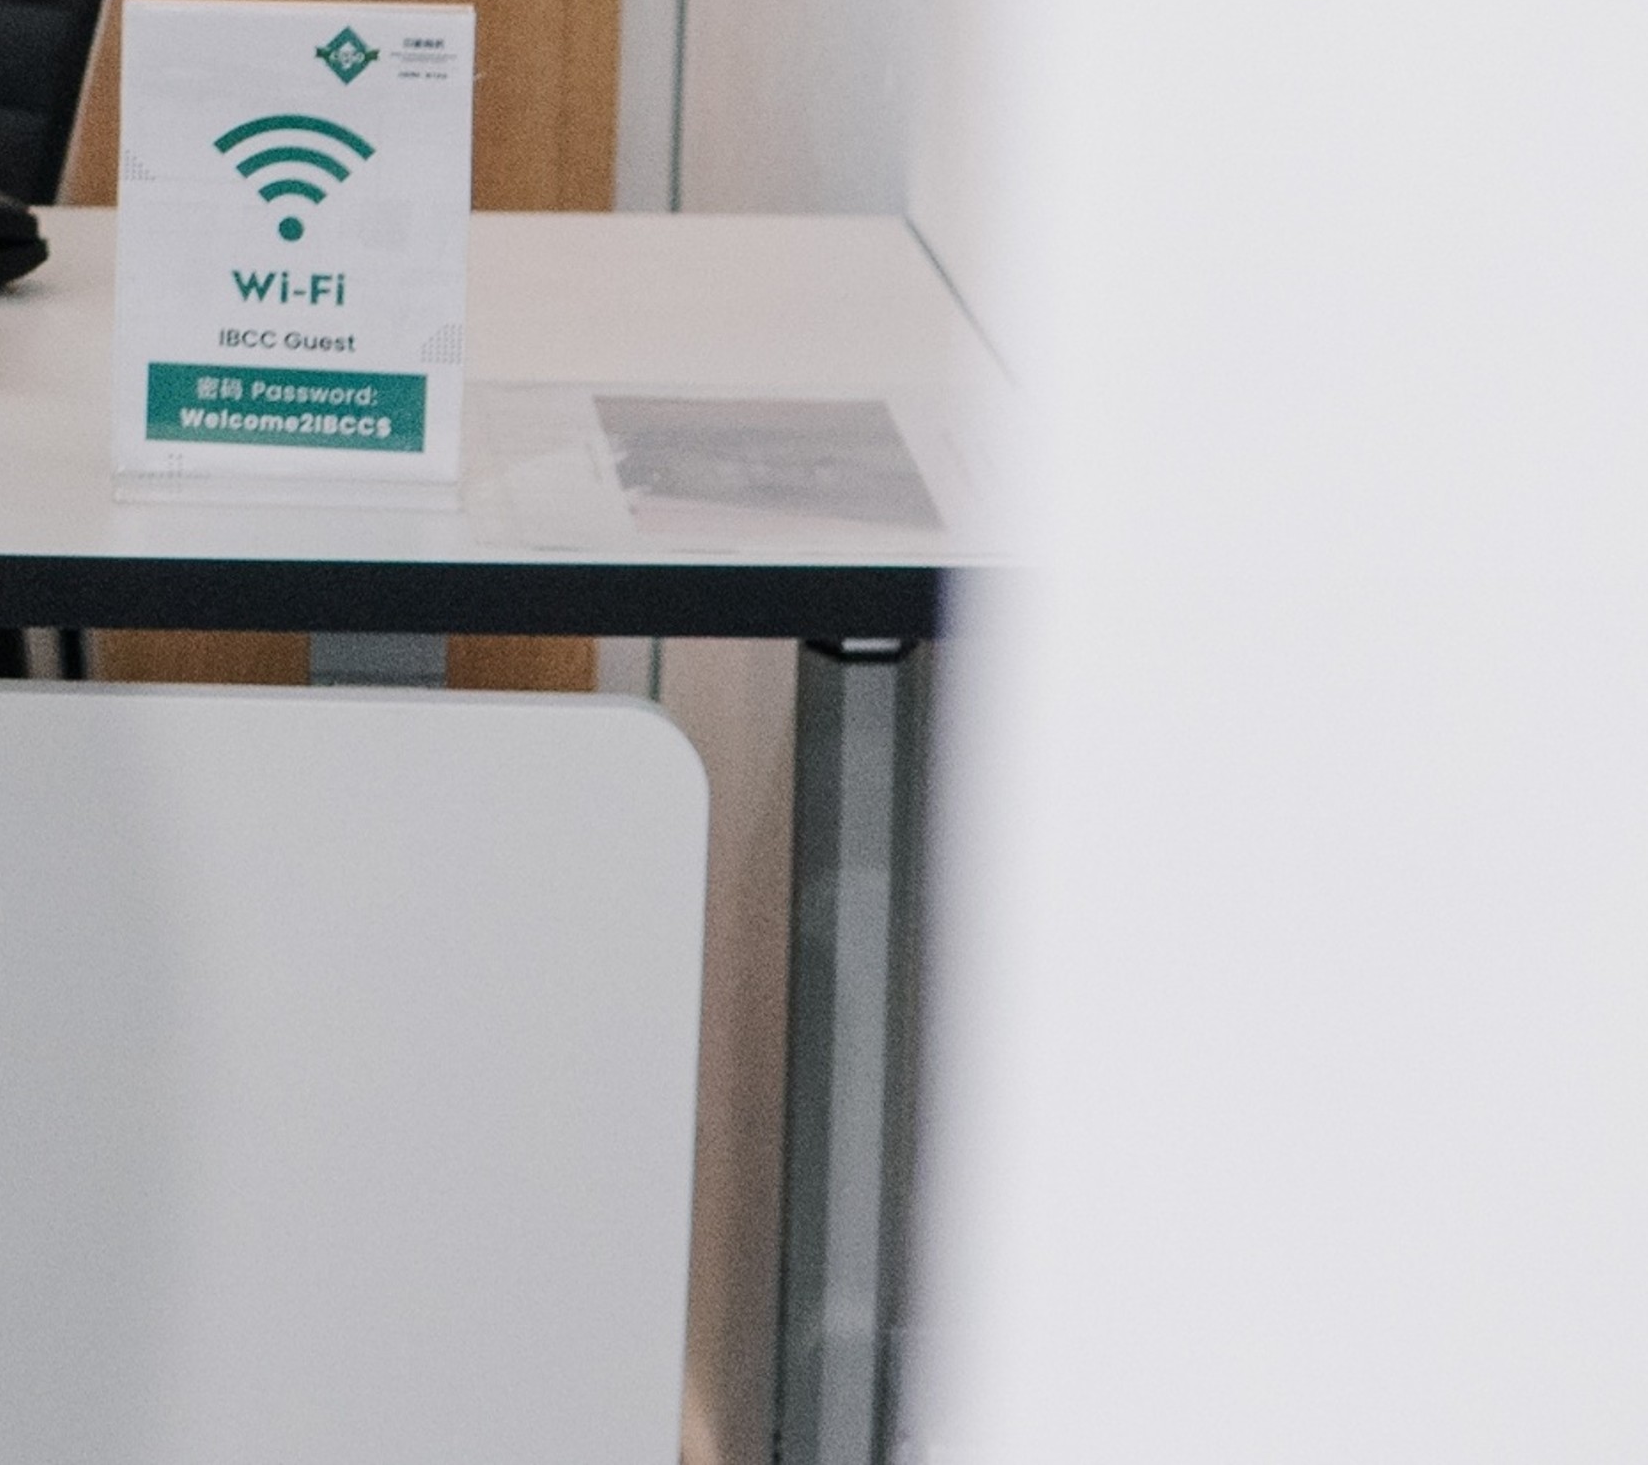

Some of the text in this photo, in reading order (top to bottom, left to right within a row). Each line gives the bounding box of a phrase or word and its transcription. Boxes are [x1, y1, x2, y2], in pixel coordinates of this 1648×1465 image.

[231, 270, 346, 306] Wi-Fi
[219, 328, 357, 352] IBCC Guest
[251, 381, 379, 406] Password:
